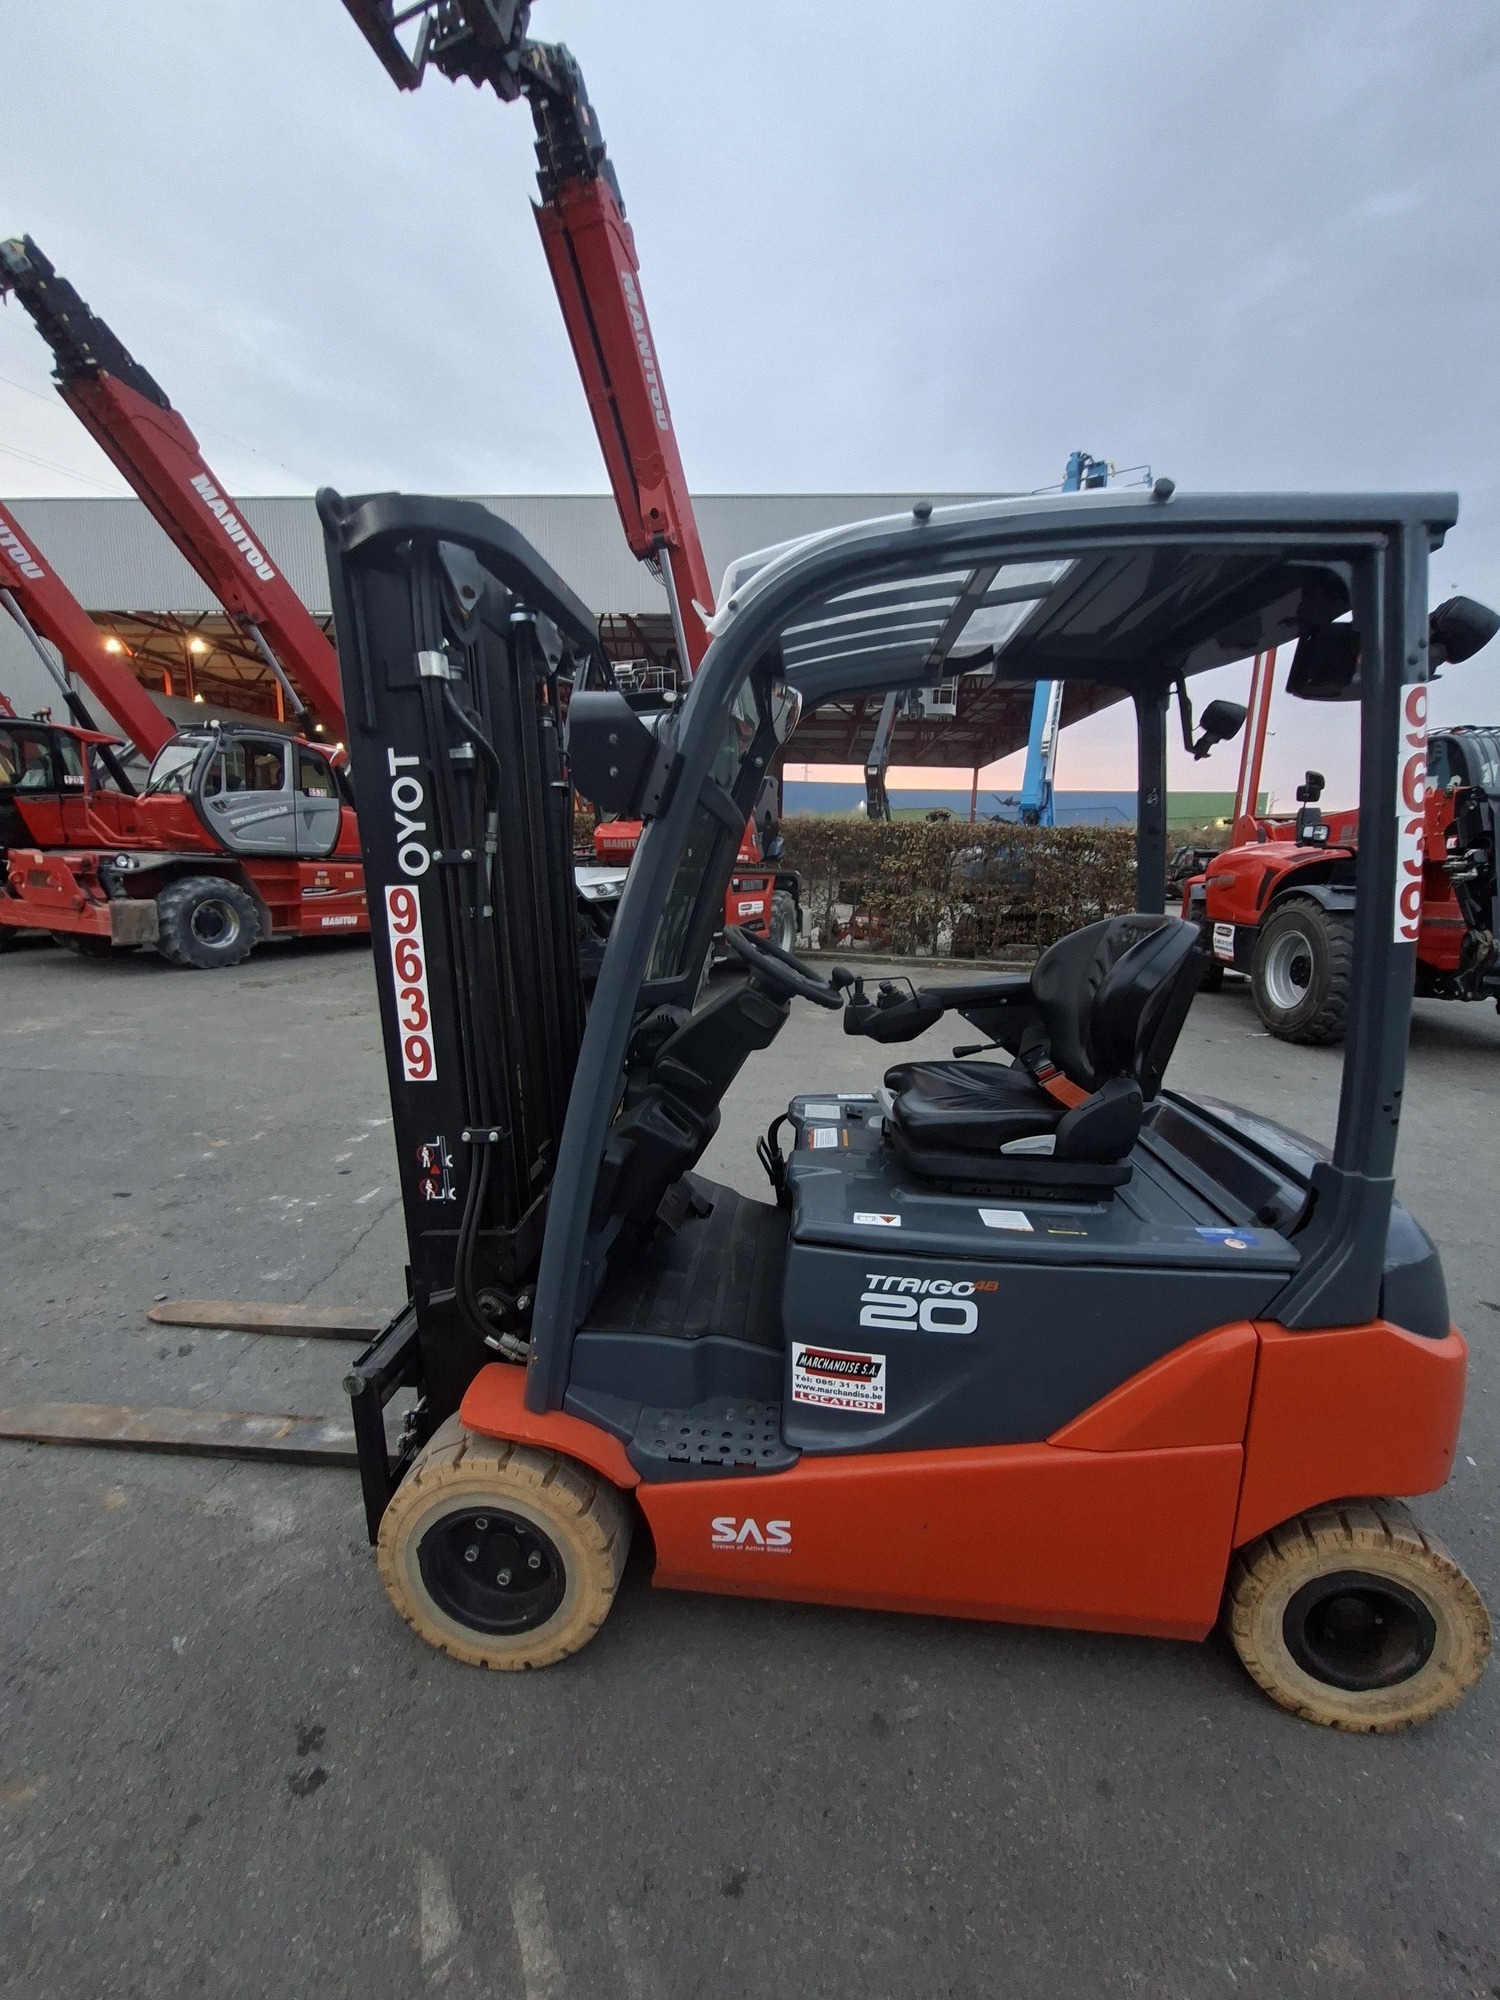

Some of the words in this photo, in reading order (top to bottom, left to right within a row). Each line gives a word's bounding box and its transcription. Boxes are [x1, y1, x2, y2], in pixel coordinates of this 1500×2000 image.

[621, 271, 669, 431] MANITOU
[190, 473, 276, 582] MANITOU
[0, 518, 46, 579] ITOU
[1400, 686, 1427, 940] 9639
[603, 839, 638, 849] MANITO
[321, 915, 358, 926] MANITOU
[388, 887, 434, 1080] 9639
[859, 1292, 979, 1335] 20
[798, 1355, 860, 1374] MARCHANDISE
[861, 1365, 877, 1376] S.A.
[795, 1374, 813, 1383] Tél:
[815, 1378, 836, 1387] 085/
[795, 1382, 883, 1400] www.marchandise.be
[800, 1391, 878, 1410] LOCATION
[711, 1517, 792, 1546] SAS
